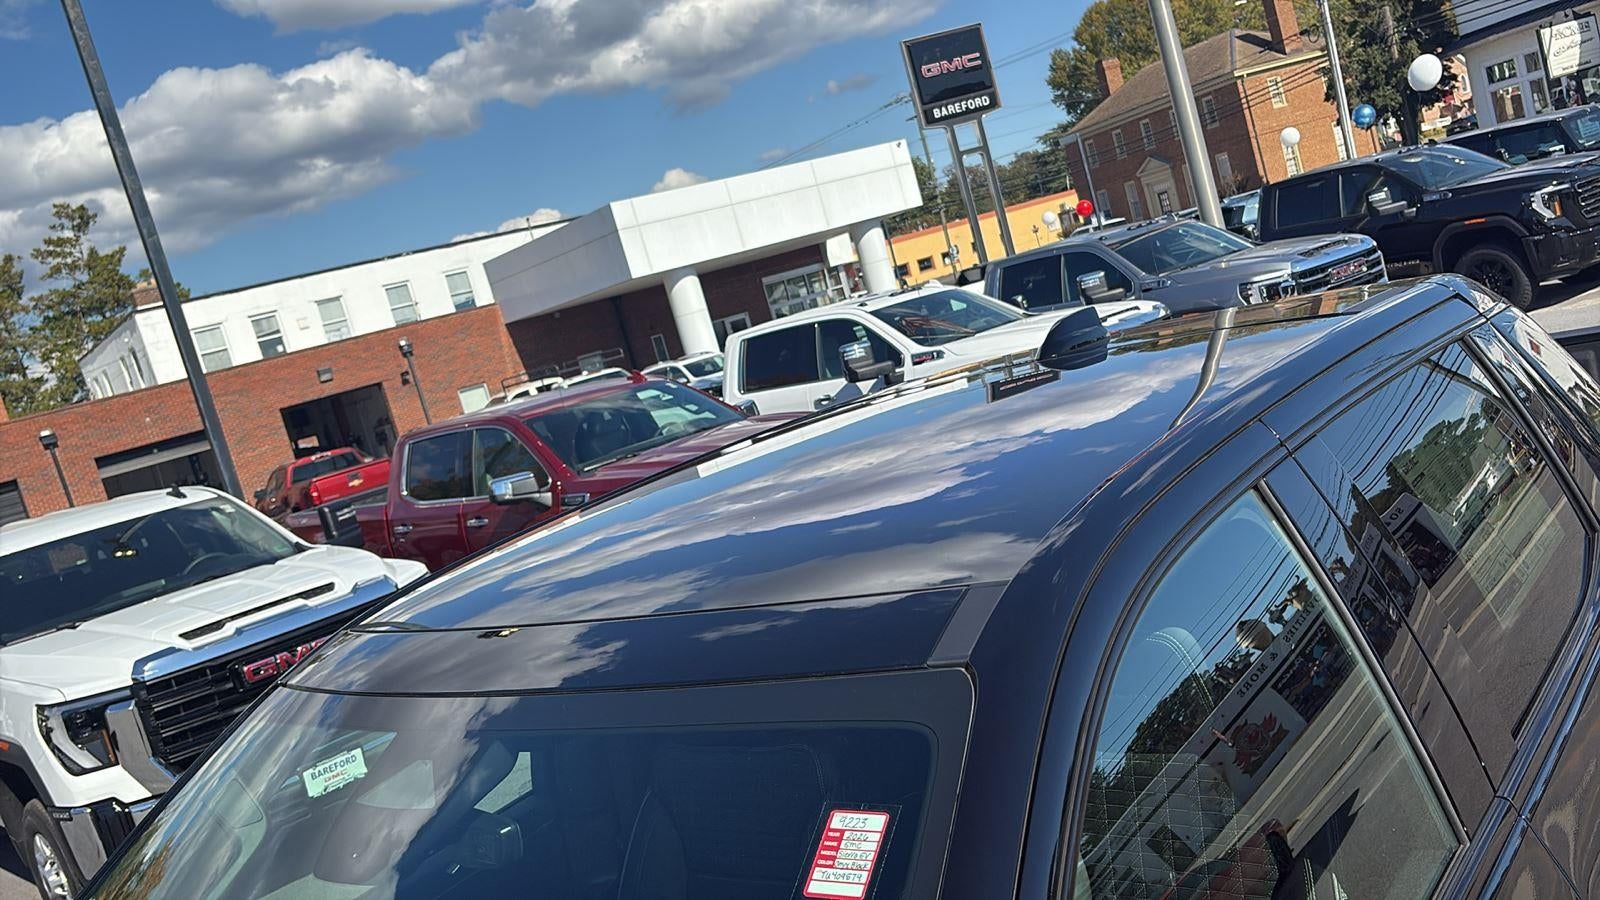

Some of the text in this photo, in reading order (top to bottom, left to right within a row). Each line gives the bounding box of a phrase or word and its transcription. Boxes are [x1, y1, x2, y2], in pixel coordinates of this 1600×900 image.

[921, 53, 982, 78] GMC
[932, 96, 991, 119] BAREFORD
[310, 754, 358, 781] BAREFORD
[839, 814, 869, 829] 9223
